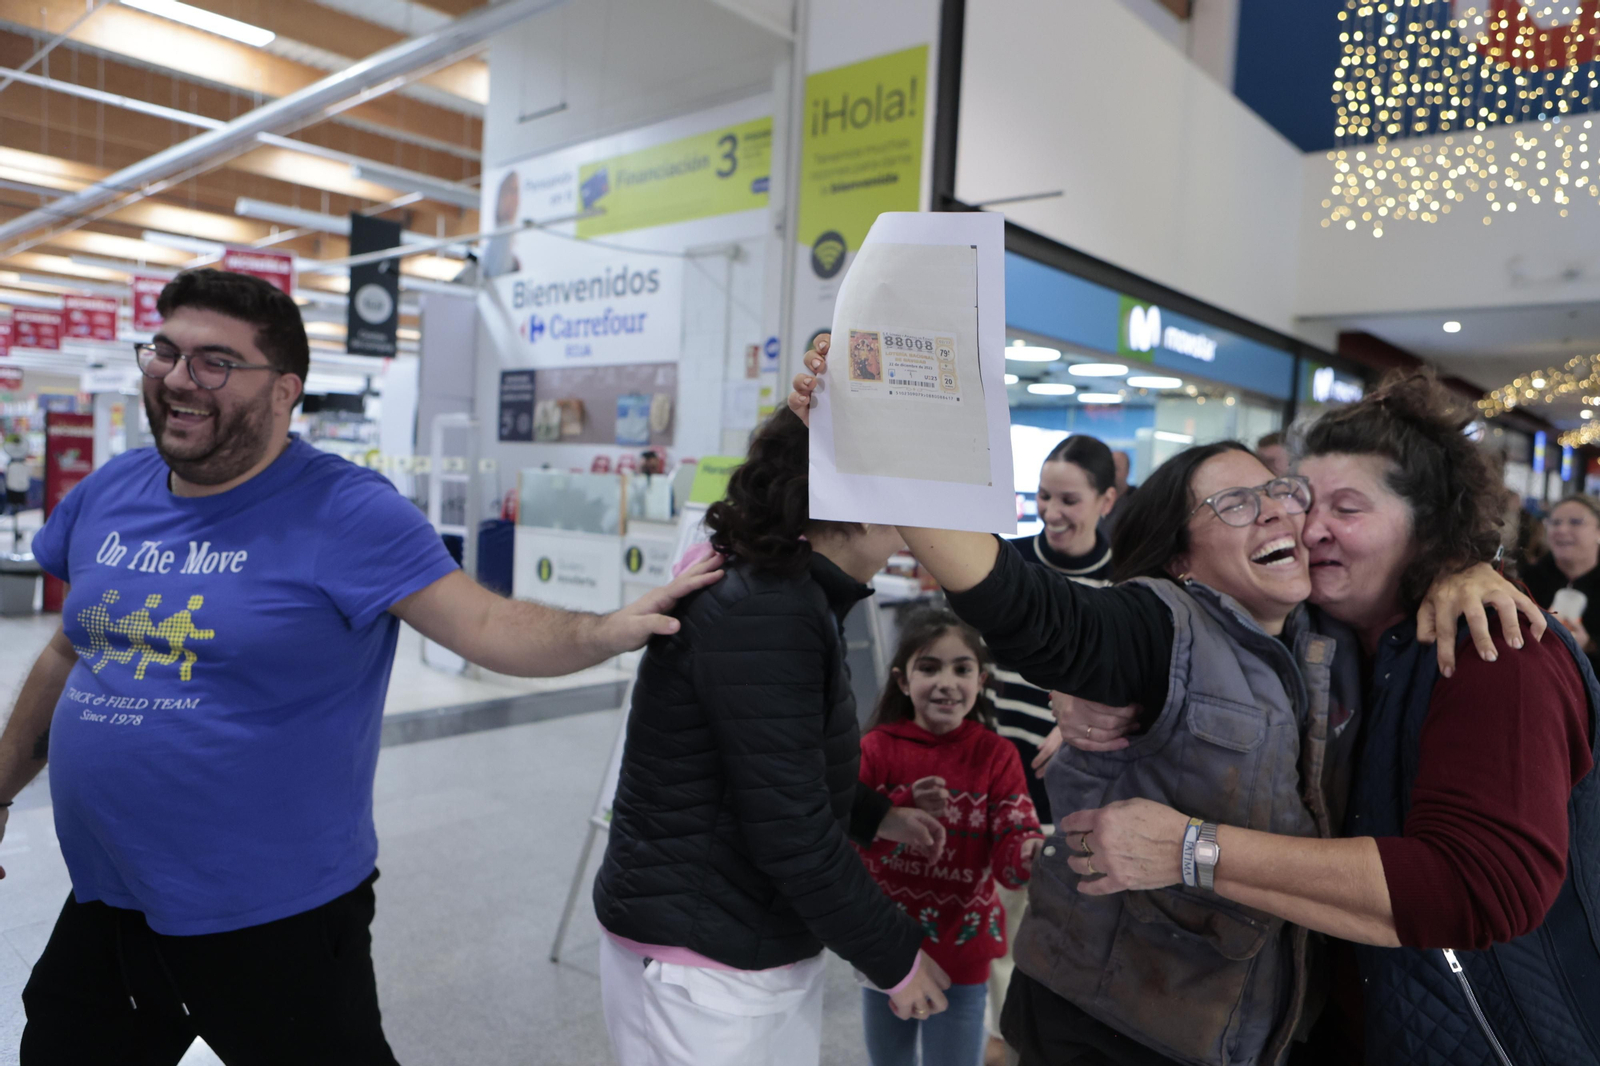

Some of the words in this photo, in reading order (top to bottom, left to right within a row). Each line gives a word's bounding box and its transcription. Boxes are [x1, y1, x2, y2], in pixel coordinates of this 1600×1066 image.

[811, 75, 918, 137] ¡Hola!
[715, 133, 738, 179] 3
[513, 265, 660, 309] Bienvenidos
[549, 307, 647, 340] Carrefour
[884, 335, 934, 351] 88008
[944, 378, 953, 386] 20
[96, 531, 128, 567] On
[128, 541, 175, 574] The
[180, 541, 248, 575] Move
[80, 709, 107, 723] Since
[109, 713, 144, 726] 1978
[105, 695, 149, 710] FIELD
[152, 698, 200, 710] TEAM
